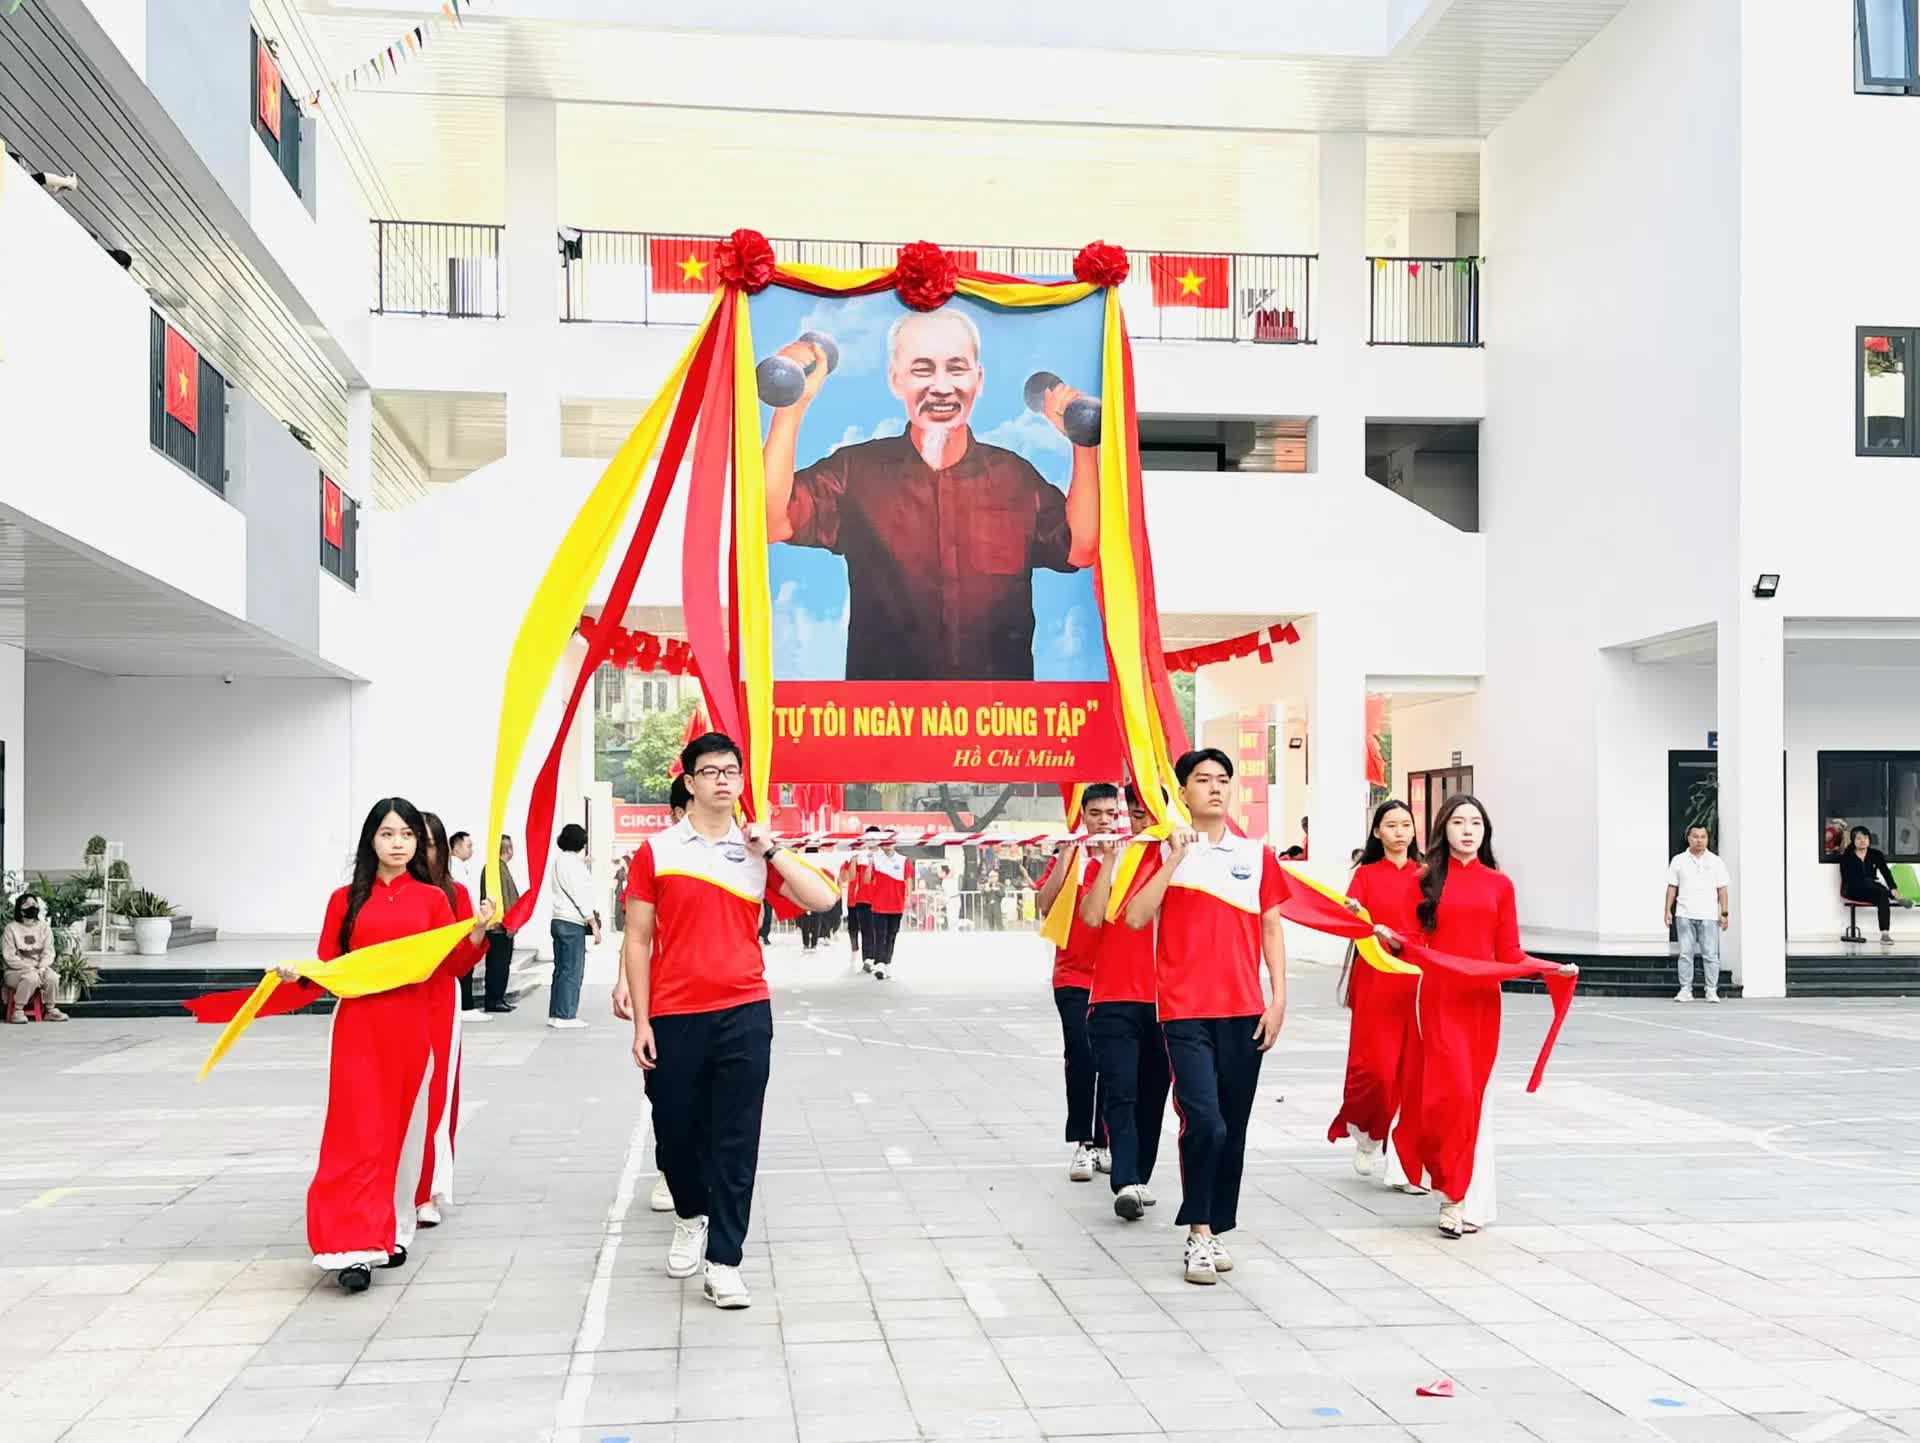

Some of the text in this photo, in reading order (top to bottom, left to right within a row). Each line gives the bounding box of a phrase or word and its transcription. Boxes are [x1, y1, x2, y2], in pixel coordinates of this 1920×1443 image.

[772, 703, 806, 744] TỰ
[809, 701, 846, 737] TÔI
[853, 701, 915, 737] NGÀY
[921, 701, 969, 737] NÀO
[975, 701, 1038, 737] CŨNG
[953, 745, 1075, 767] Hồ Chí Minh
[620, 814, 672, 827] CIRCLE
